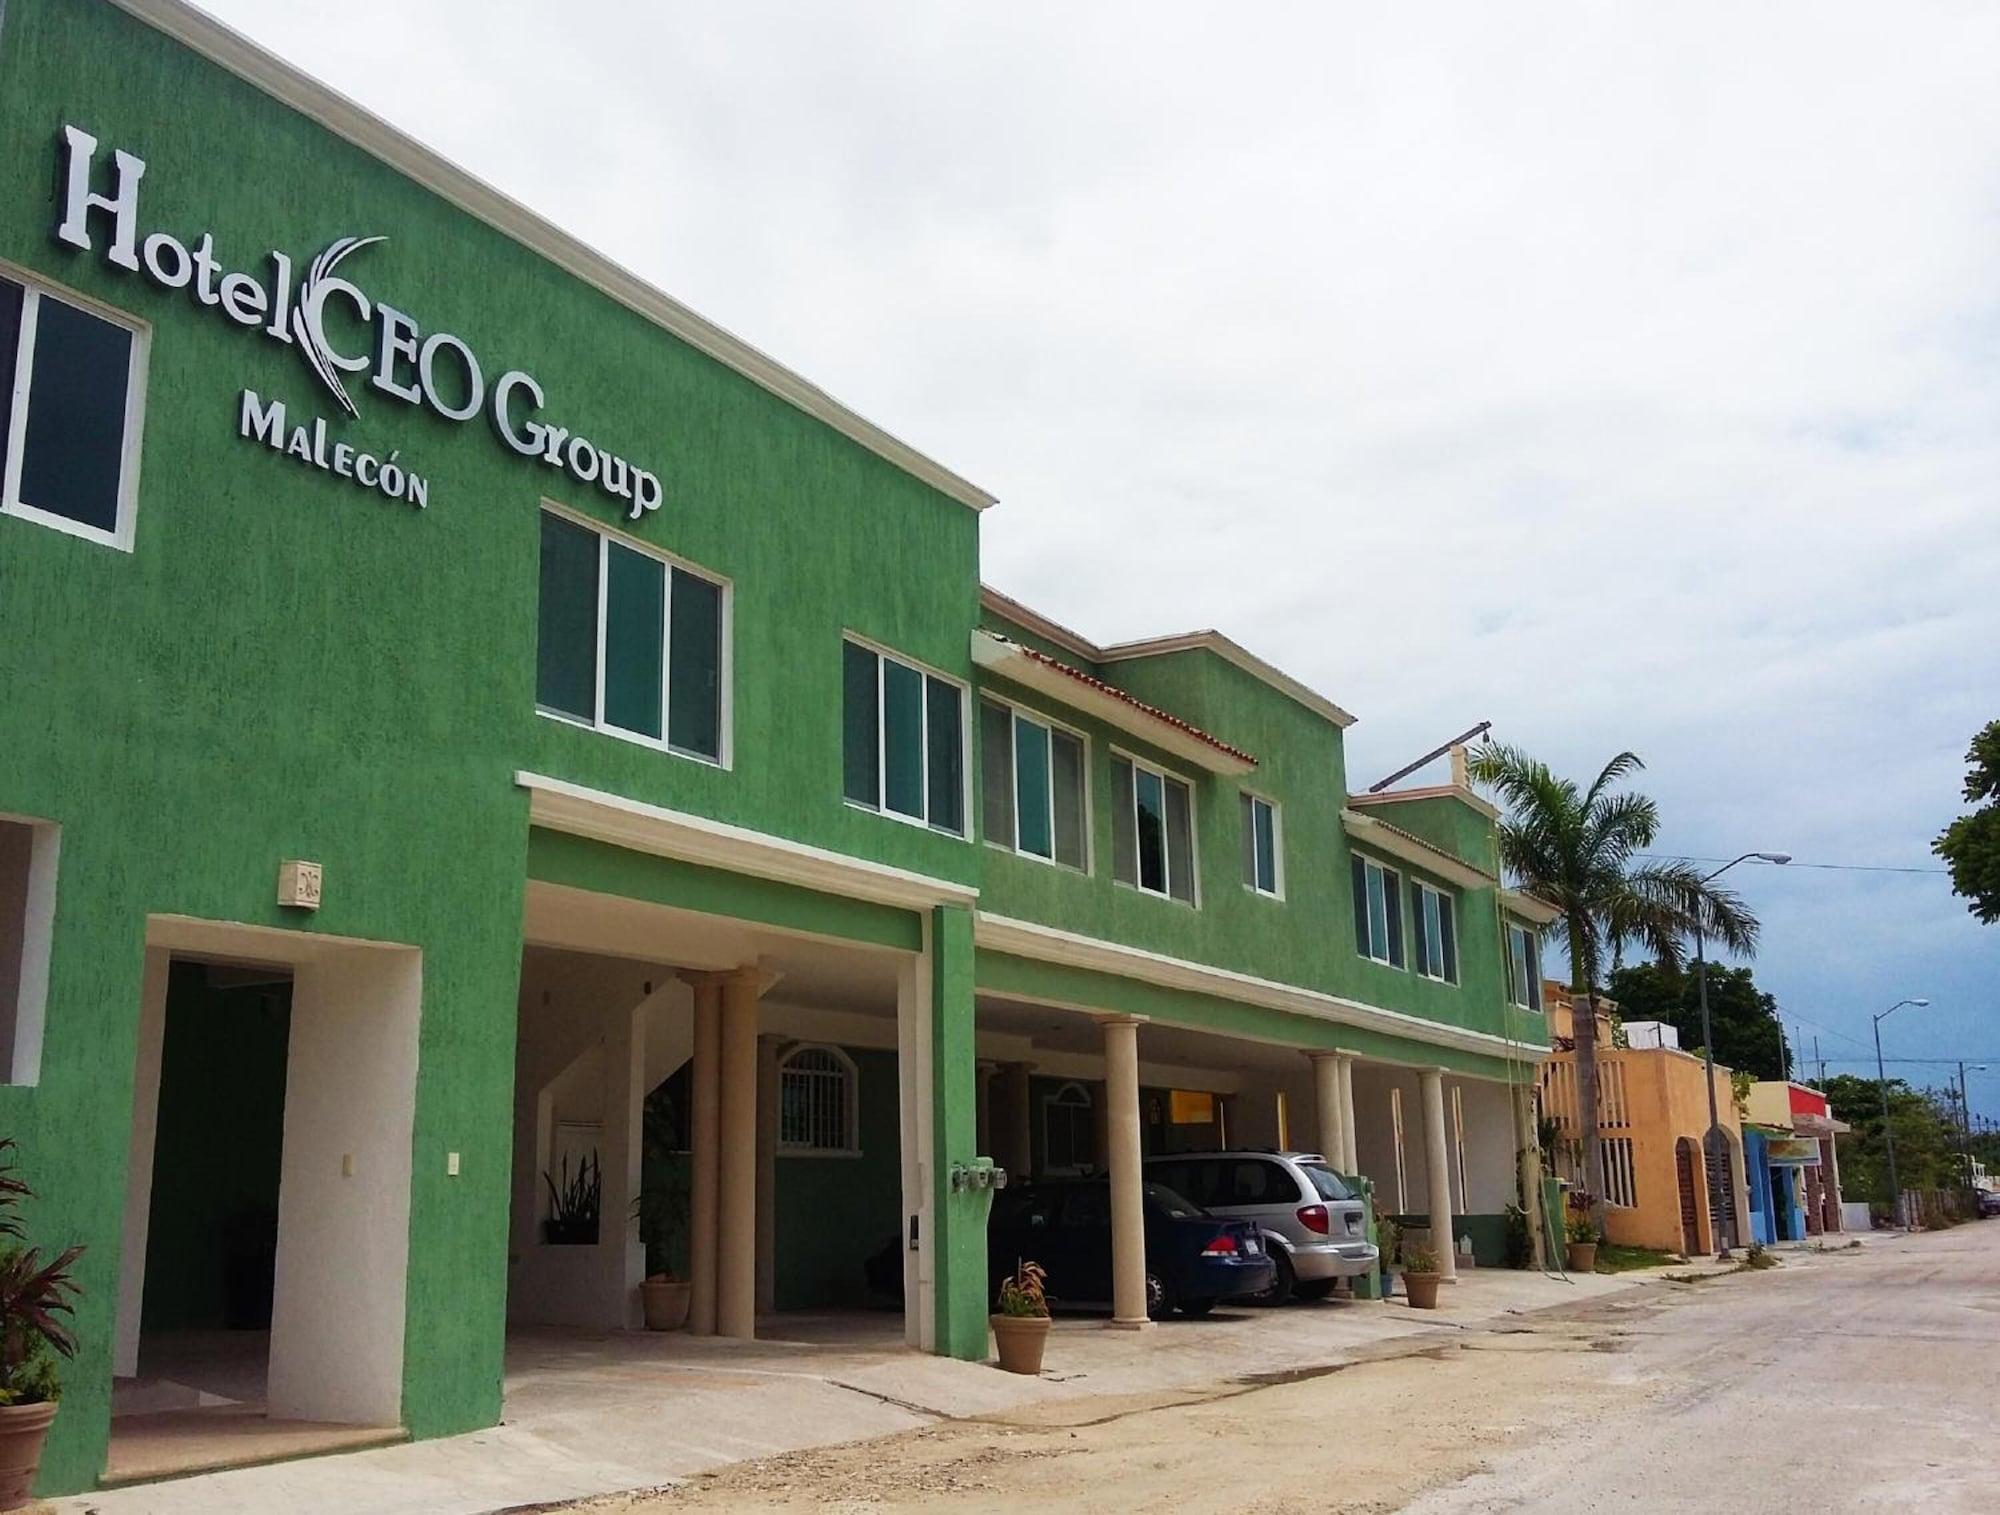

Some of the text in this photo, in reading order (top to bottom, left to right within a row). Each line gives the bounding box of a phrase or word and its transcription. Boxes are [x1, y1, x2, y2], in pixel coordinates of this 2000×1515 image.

[58, 124, 664, 519] Hotel CEO Group
